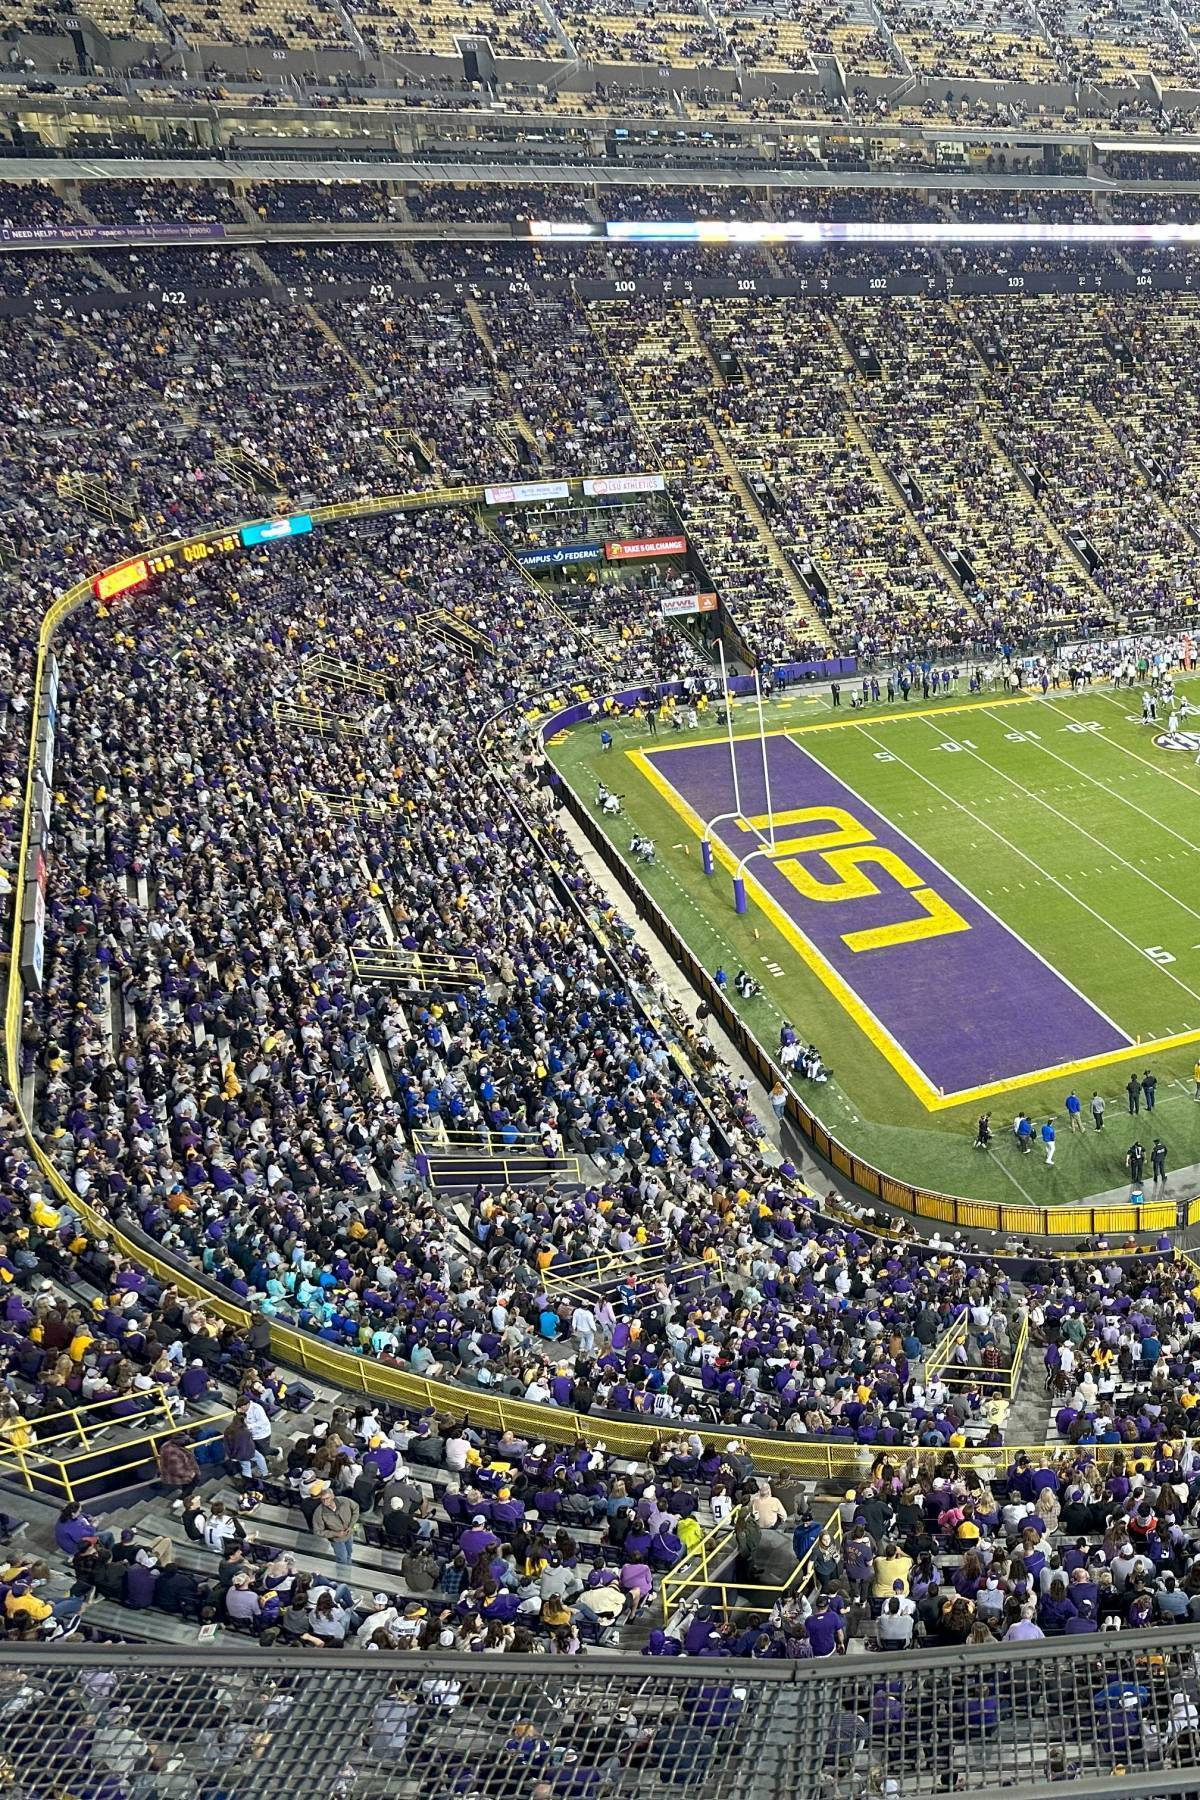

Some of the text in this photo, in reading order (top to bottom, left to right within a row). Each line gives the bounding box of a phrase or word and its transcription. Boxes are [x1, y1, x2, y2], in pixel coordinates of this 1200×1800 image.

[12, 230, 33, 238] NEED
[34, 229, 57, 238] HELP?
[60, 229, 75, 237] Text
[615, 281, 636, 292] 100
[738, 280, 756, 291] 101
[870, 279, 887, 289] 102
[1008, 277, 1025, 287] 103
[1136, 275, 1152, 286] 104
[162, 291, 186, 304] 422
[623, 480, 658, 490] ATHLETICS
[184, 543, 207, 562] 0:00
[624, 544, 640, 553] TAKE
[644, 543, 656, 551] OIL
[656, 541, 683, 550] CHANGE
[519, 550, 597, 565] CAMPUS FEDERAL
[663, 599, 695, 609] WWL
[1065, 720, 1106, 734] 20
[1003, 730, 1042, 744] 15
[939, 739, 979, 753] 10
[873, 751, 897, 763] 5
[734, 805, 973, 953] LSU
[1144, 945, 1177, 964] 5
[930, 1388, 937, 1399] 7
[655, 1397, 665, 1409] 10
[714, 1505, 723, 1519] 9
